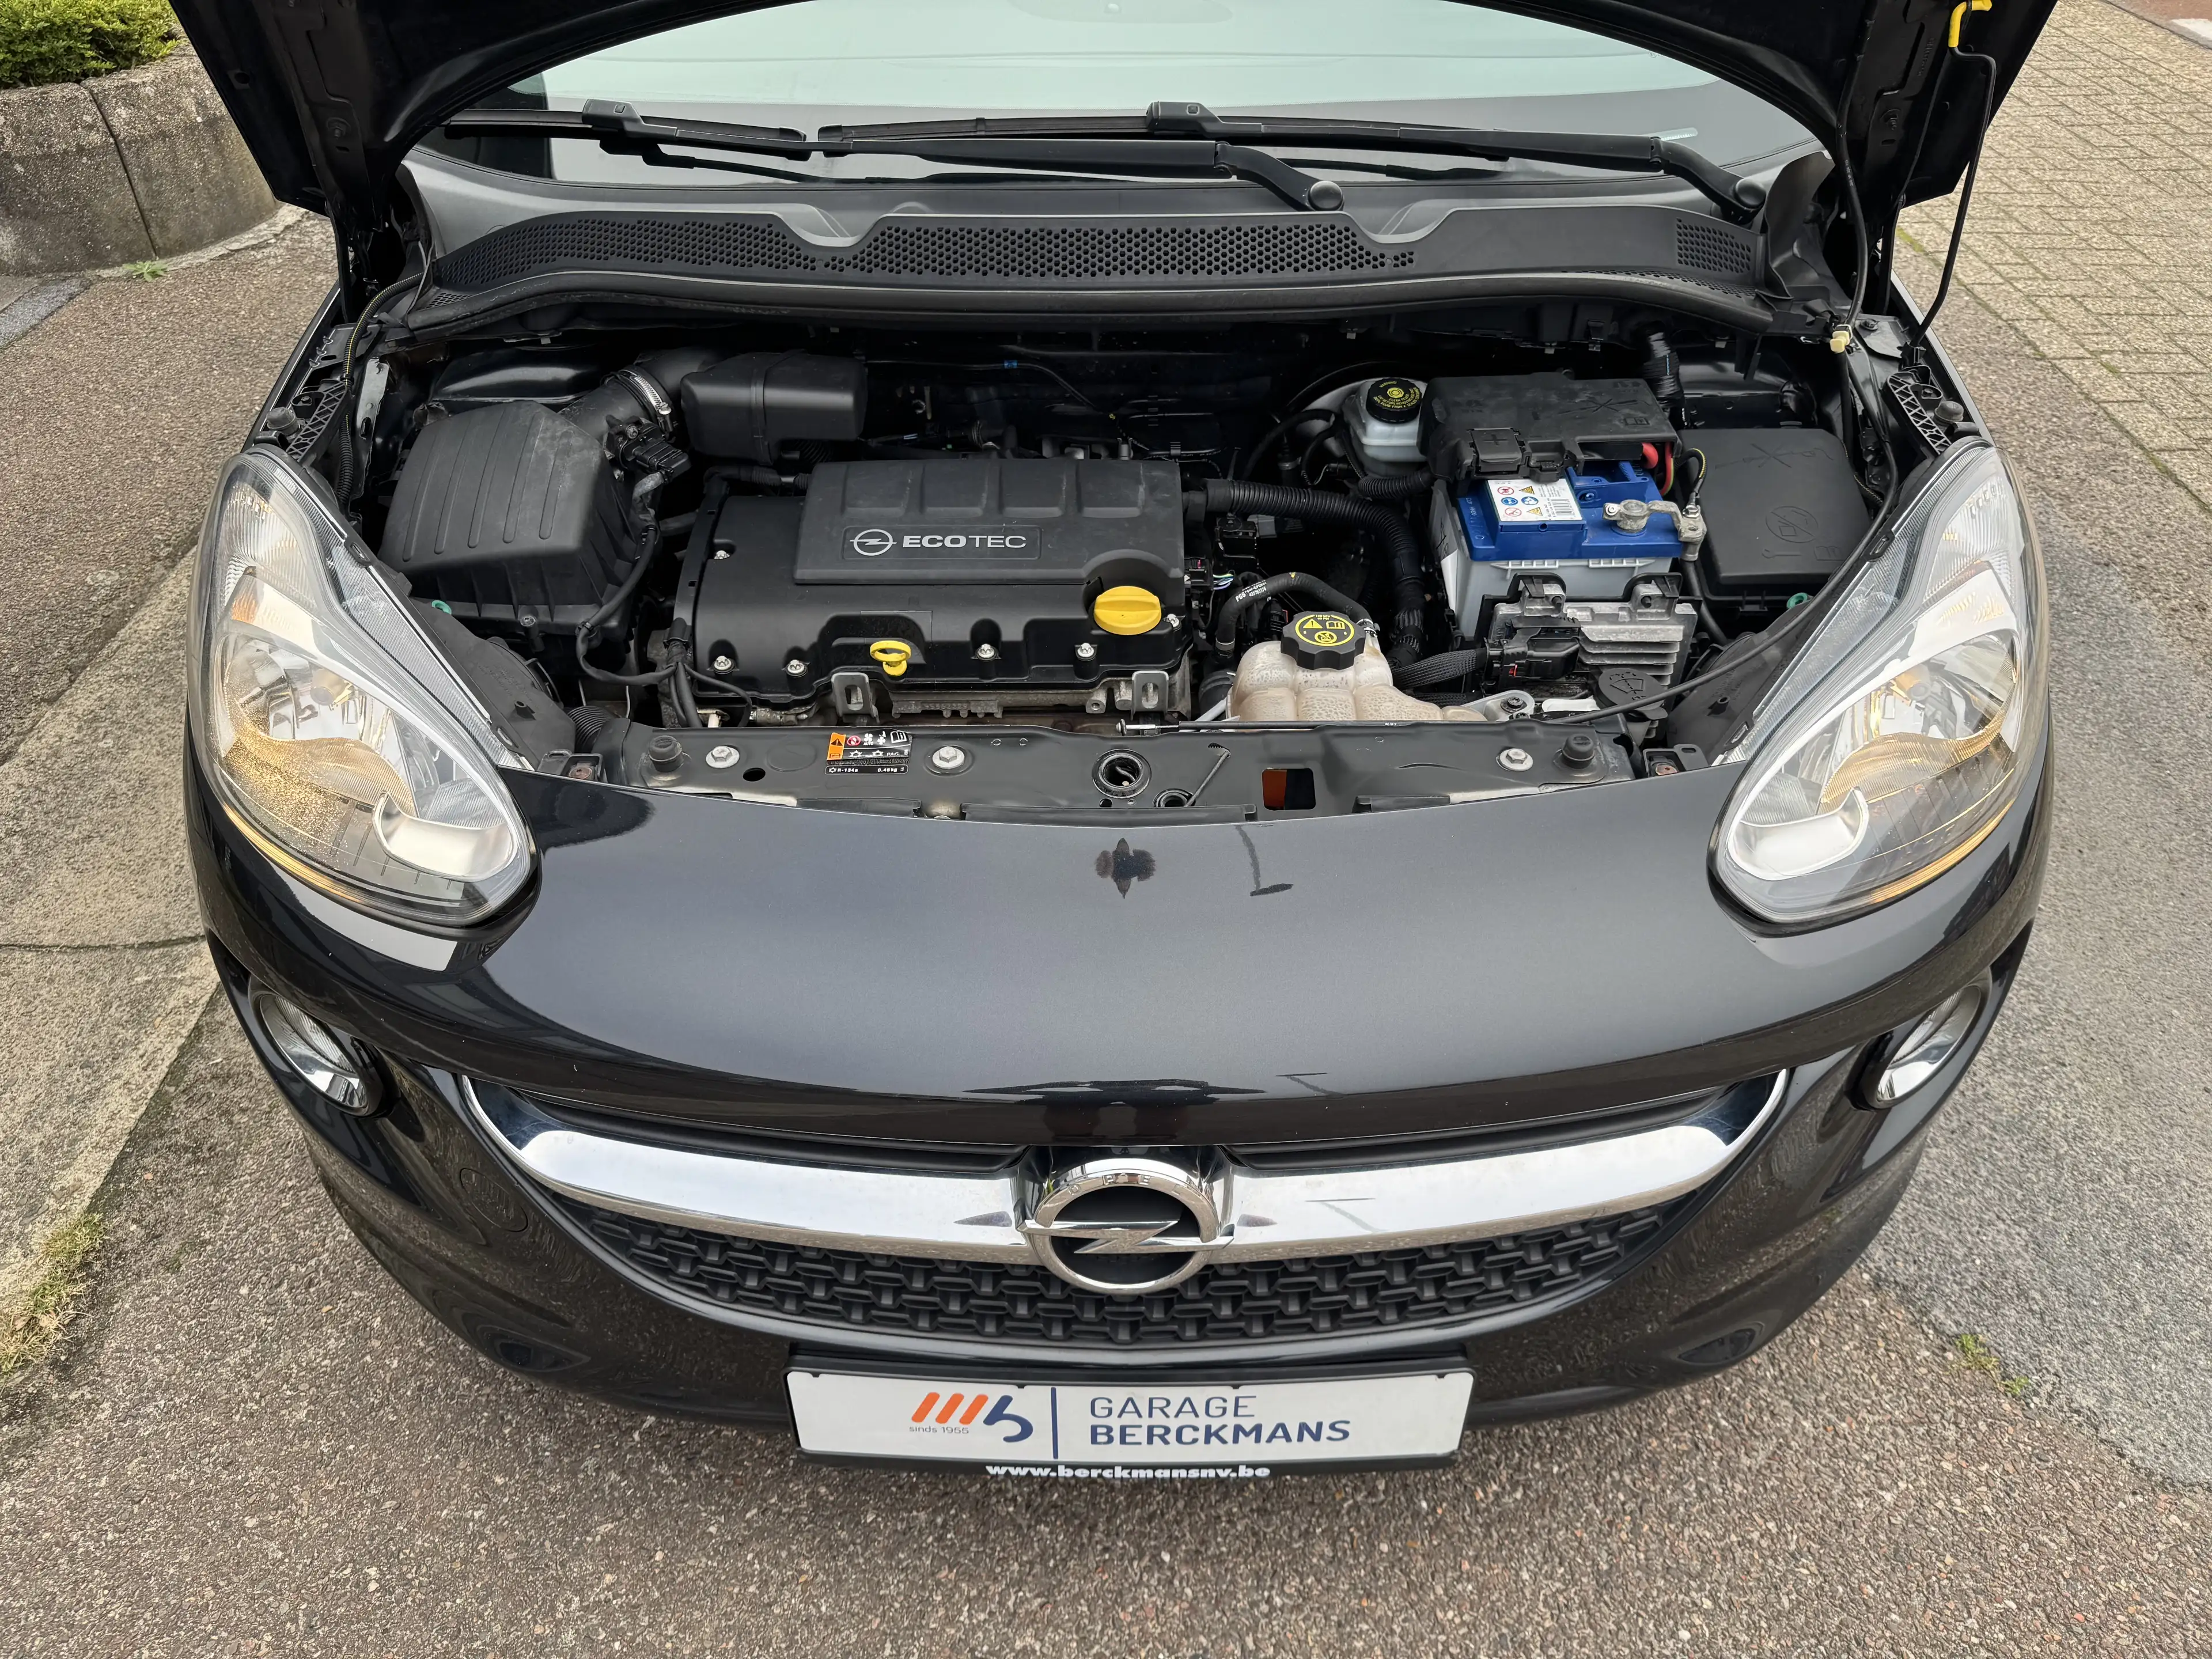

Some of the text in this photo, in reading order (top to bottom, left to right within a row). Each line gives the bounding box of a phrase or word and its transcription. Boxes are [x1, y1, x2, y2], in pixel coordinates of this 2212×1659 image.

[903, 535, 1027, 548] ECOTEC
[1090, 1395, 1257, 1419] GARAGE
[1090, 1420, 1351, 1445] BERCKMANS
[986, 1465, 1271, 1479] www.berckmansnv.be
